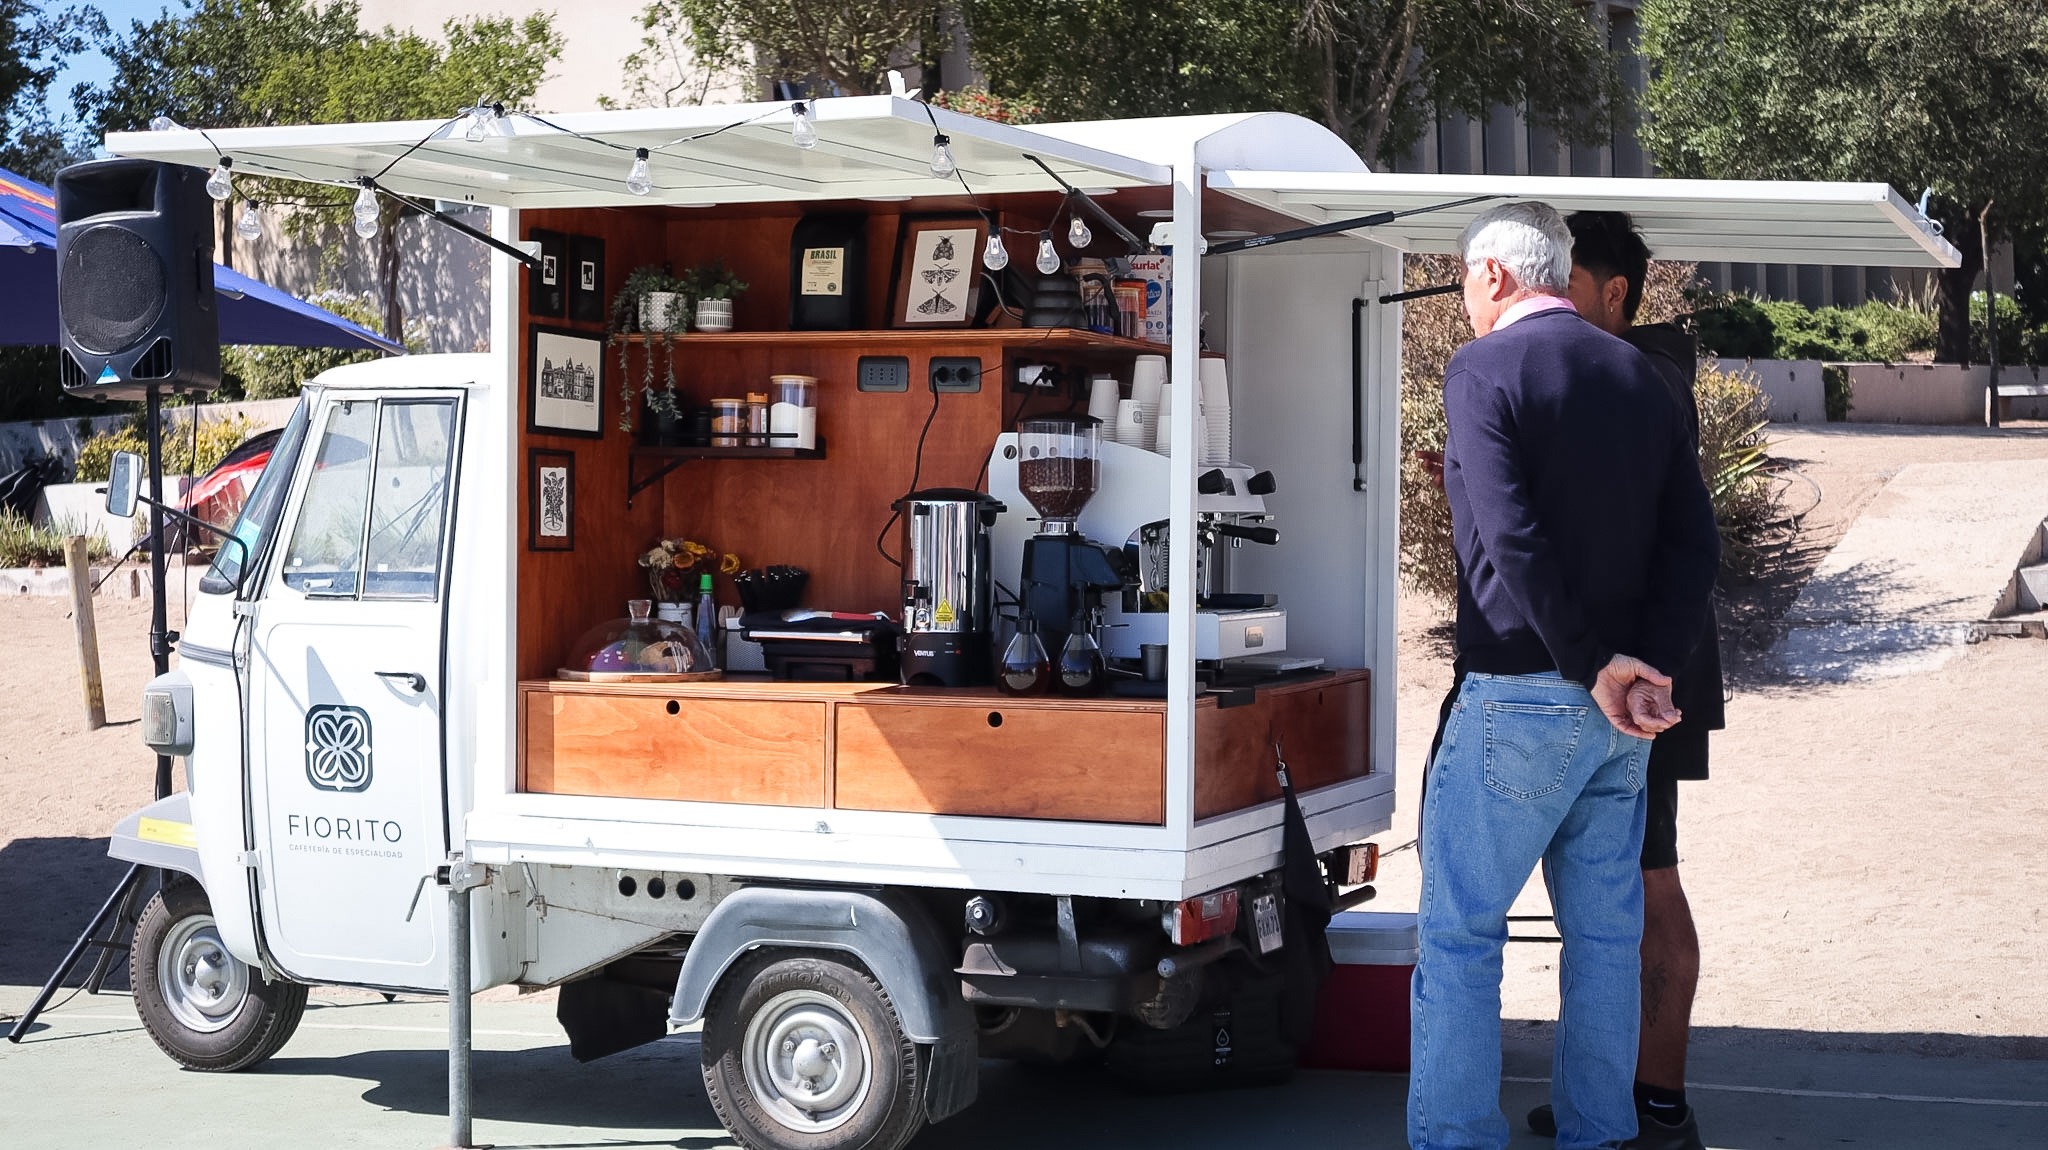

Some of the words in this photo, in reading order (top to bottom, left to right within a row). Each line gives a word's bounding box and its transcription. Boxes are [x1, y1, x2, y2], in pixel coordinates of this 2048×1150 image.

[811, 250, 837, 260] BRASIL
[1131, 260, 1160, 270] surlat
[288, 814, 402, 843] FIORITO
[332, 847, 342, 855] DE
[345, 848, 403, 859] ESPECIALIDAD
